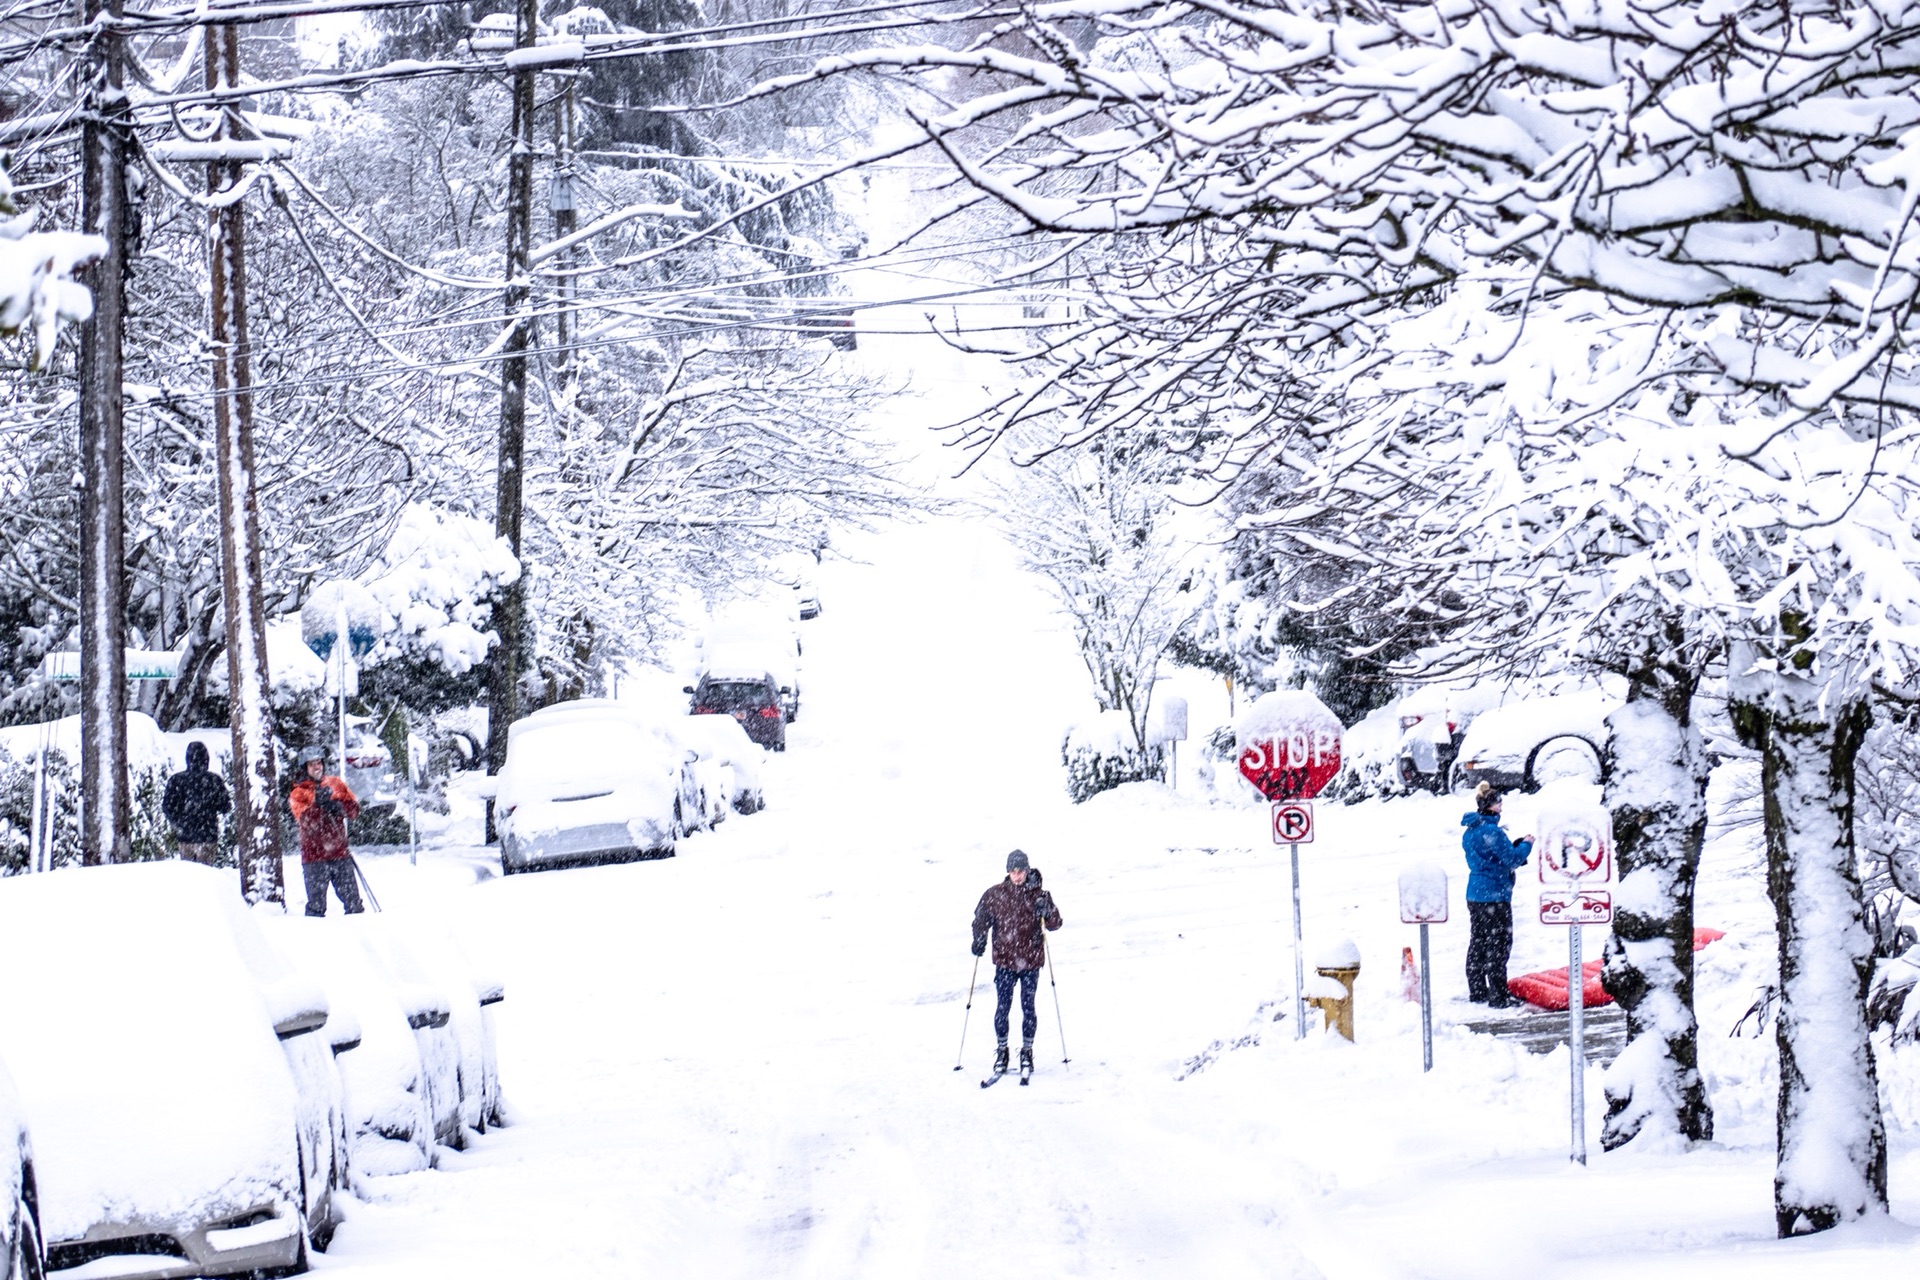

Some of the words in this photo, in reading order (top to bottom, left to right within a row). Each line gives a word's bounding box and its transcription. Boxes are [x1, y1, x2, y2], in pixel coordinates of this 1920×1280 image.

[1244, 731, 1334, 770] STOP
[1285, 813, 1304, 835] P
[1562, 830, 1592, 869] P
